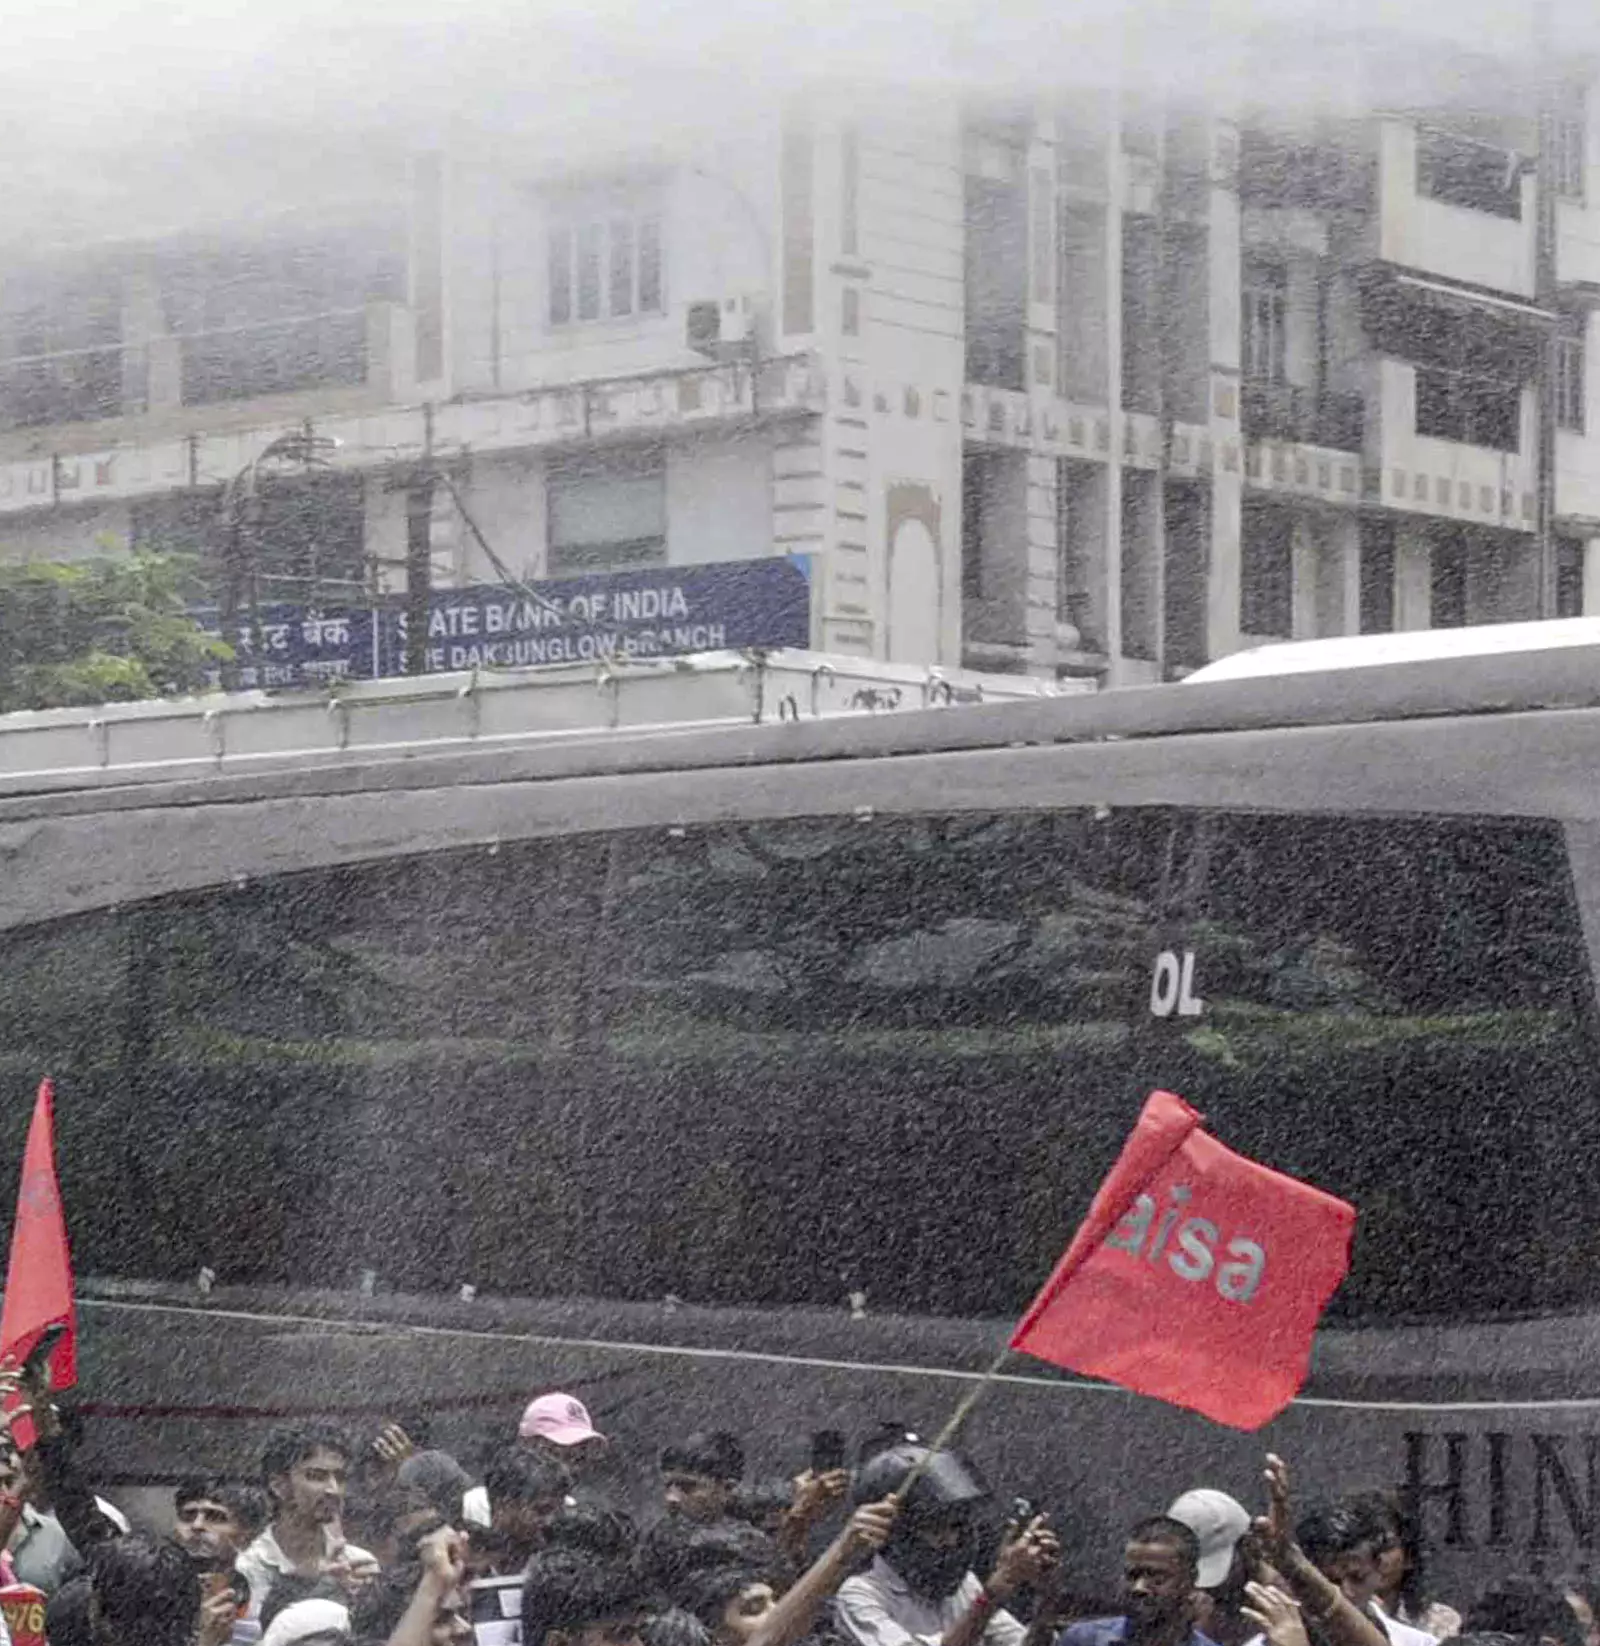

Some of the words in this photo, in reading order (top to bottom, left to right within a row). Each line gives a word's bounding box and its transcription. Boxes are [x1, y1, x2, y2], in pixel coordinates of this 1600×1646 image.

[399, 607, 479, 641] SATE
[486, 601, 562, 634] BANK
[569, 595, 606, 624] OF
[613, 587, 690, 621] INDIA
[1104, 1183, 1267, 1306] aisa
